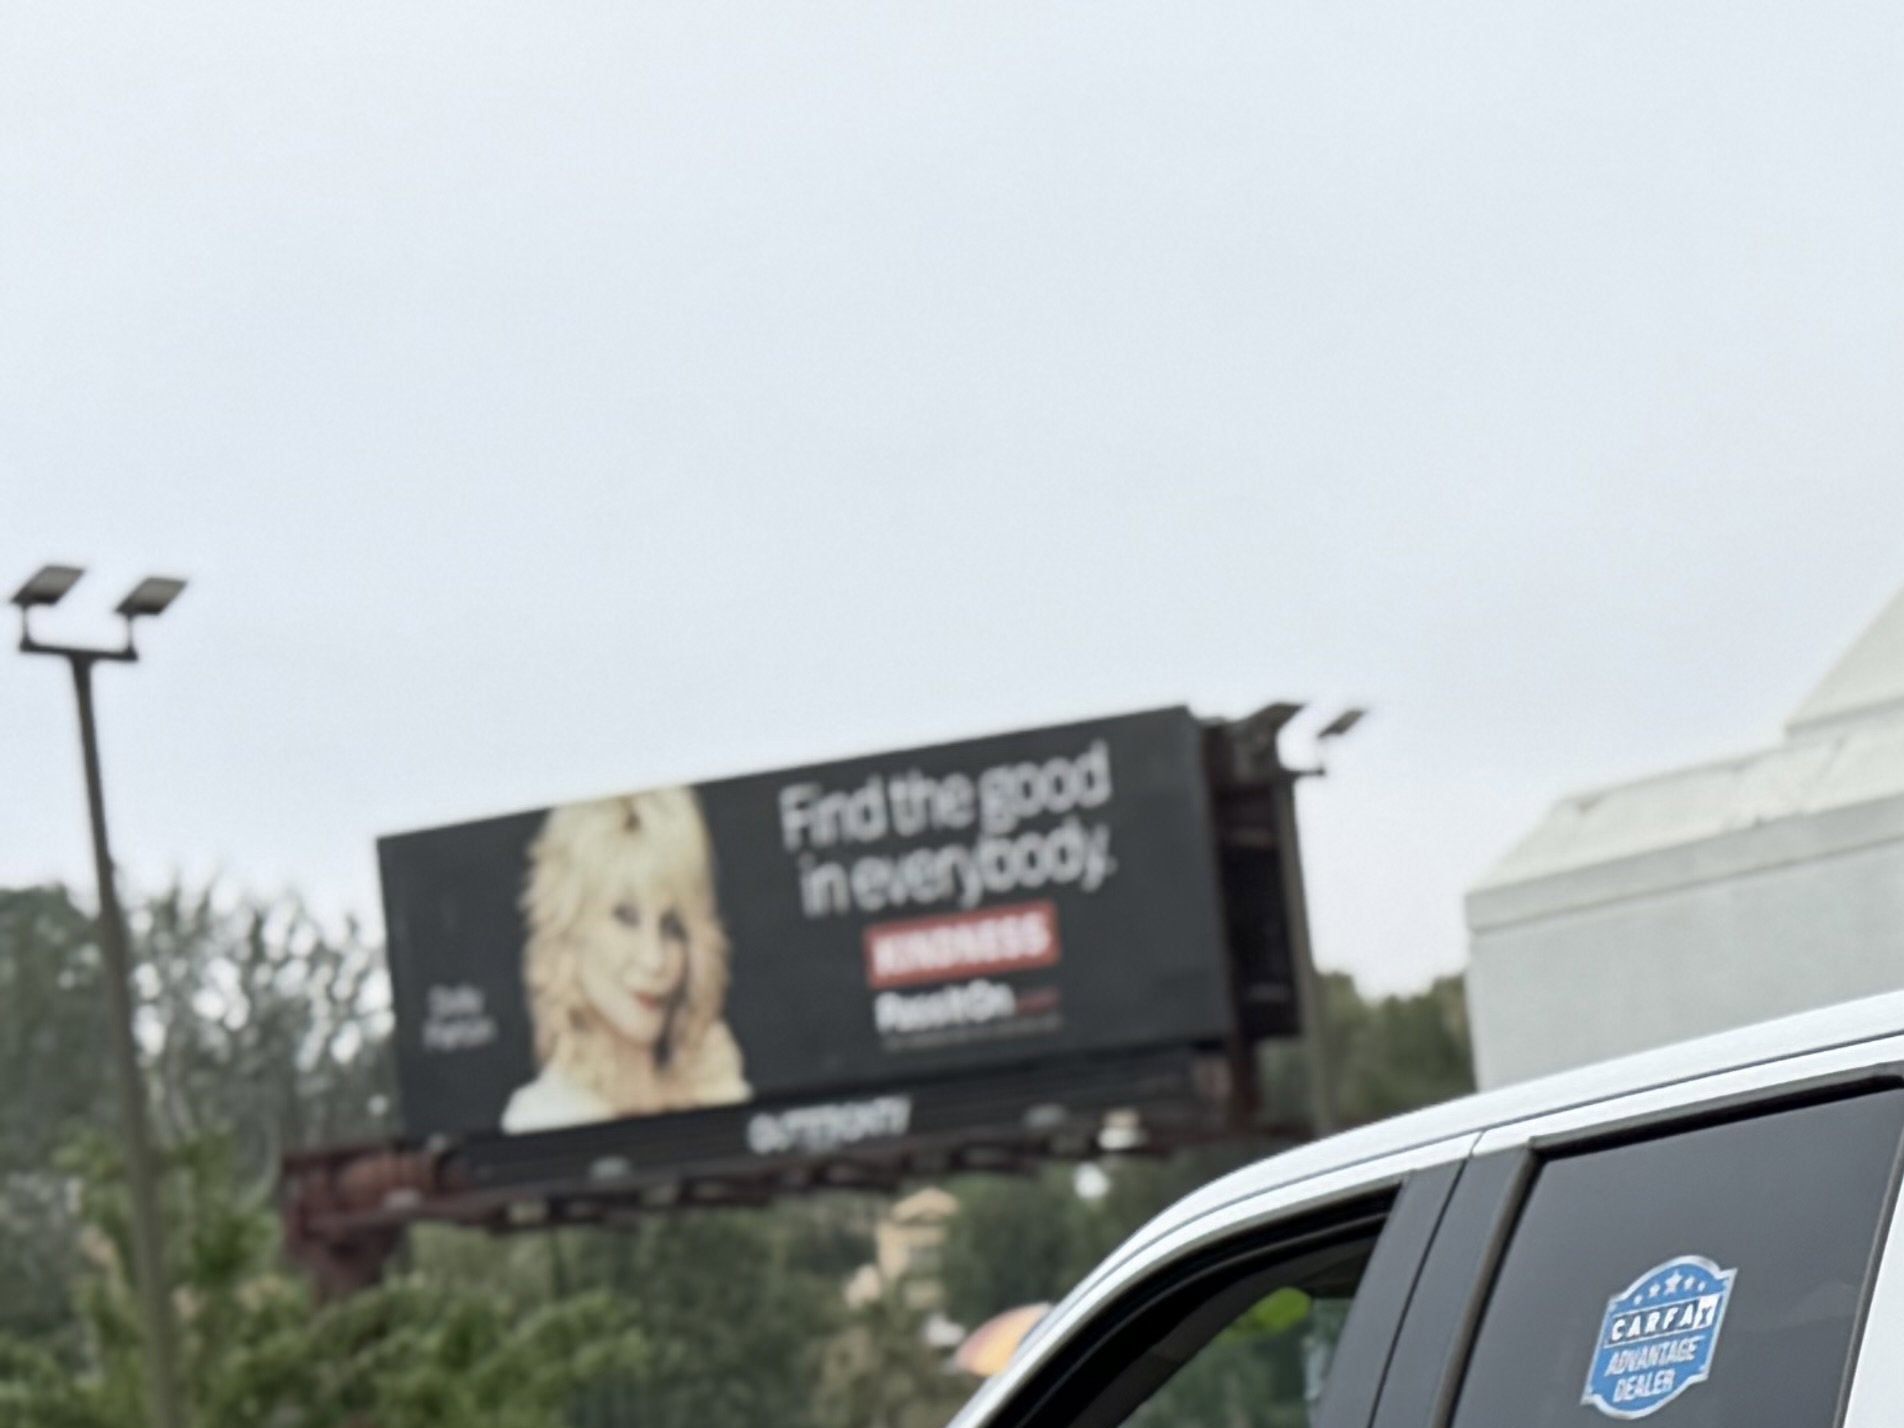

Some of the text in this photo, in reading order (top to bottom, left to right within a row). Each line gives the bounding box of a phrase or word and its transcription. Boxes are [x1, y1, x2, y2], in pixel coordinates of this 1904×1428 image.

[779, 740, 1112, 849] Find the good
[799, 853, 850, 918] in
[1611, 1295, 1719, 1343] CARFAX
[1604, 1335, 1705, 1377] ADVANTAGE
[1613, 1369, 1676, 1402] DEALER
